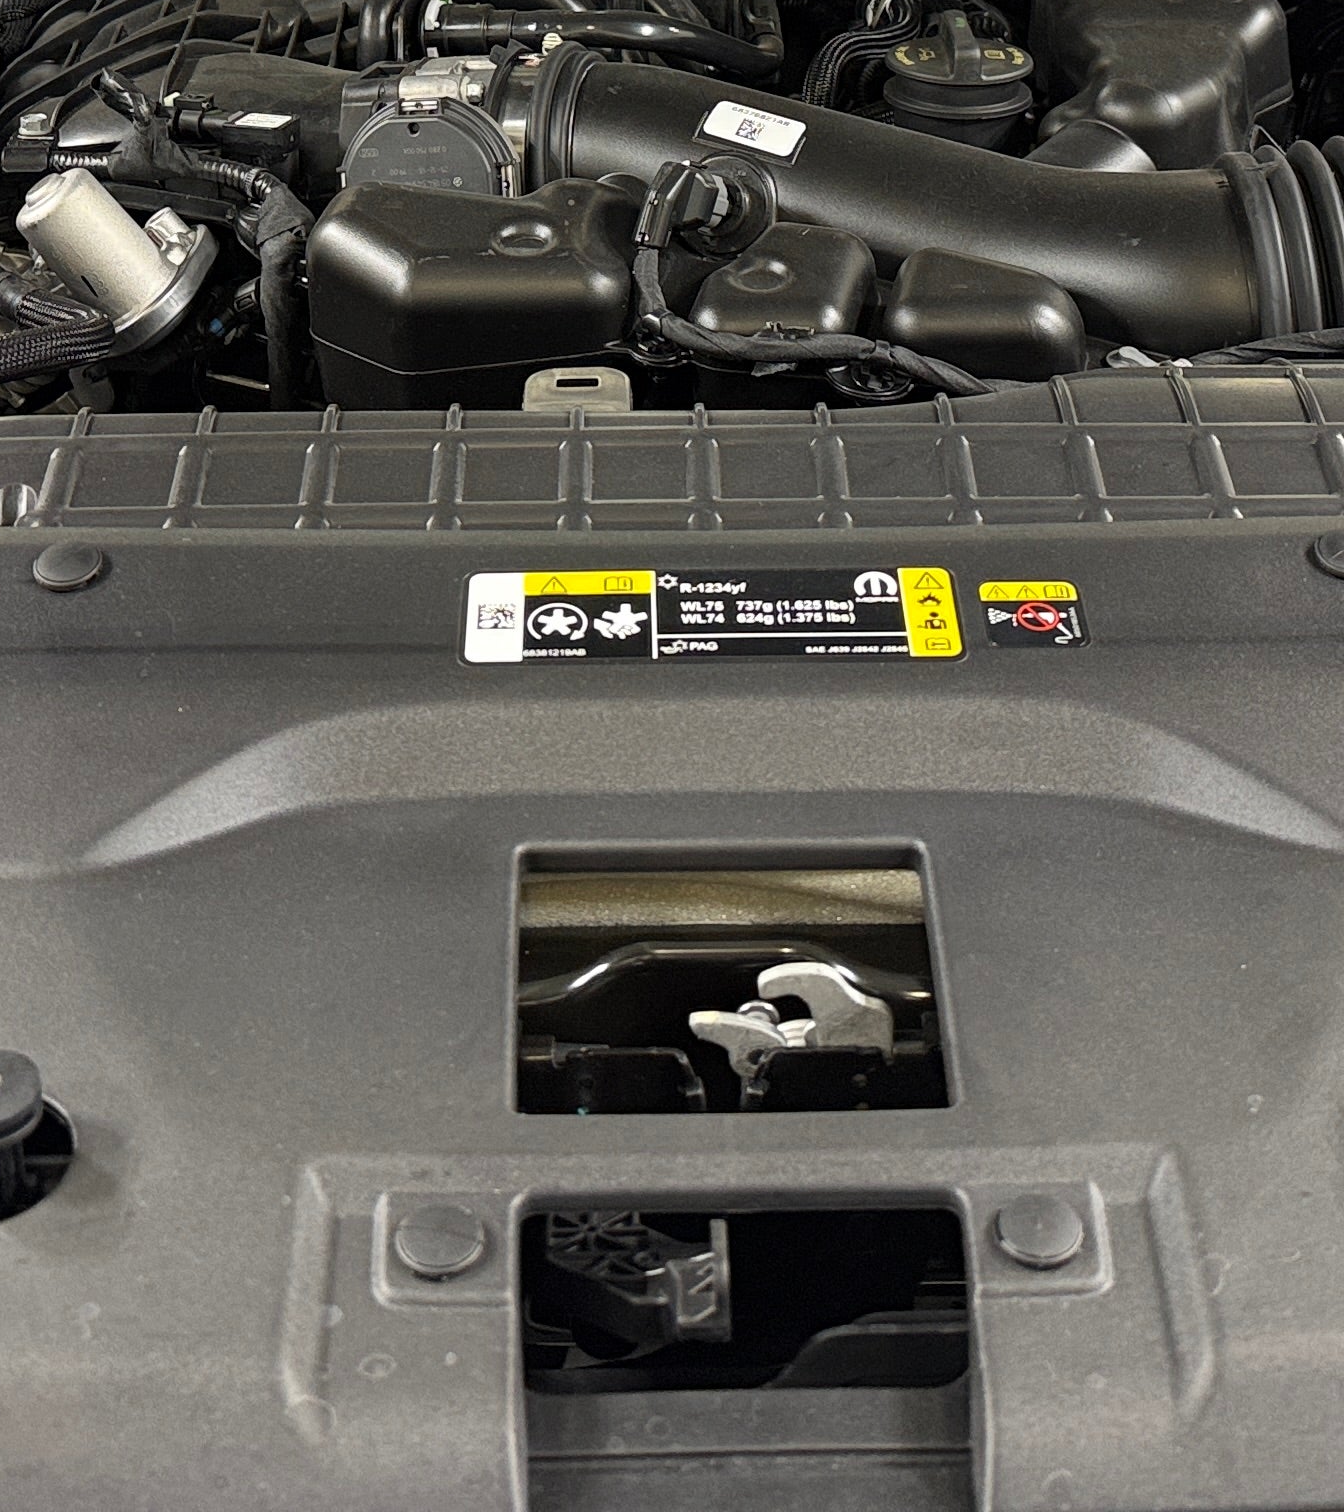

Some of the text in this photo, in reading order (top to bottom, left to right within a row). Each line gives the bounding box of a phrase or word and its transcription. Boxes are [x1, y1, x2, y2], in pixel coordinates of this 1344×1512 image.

[679, 582, 747, 595] R-1234yf
[680, 600, 725, 612] WL75
[735, 600, 774, 613] 737g
[776, 599, 823, 612] (1.625
[680, 613, 726, 624] WL74
[736, 612, 775, 625] 624g
